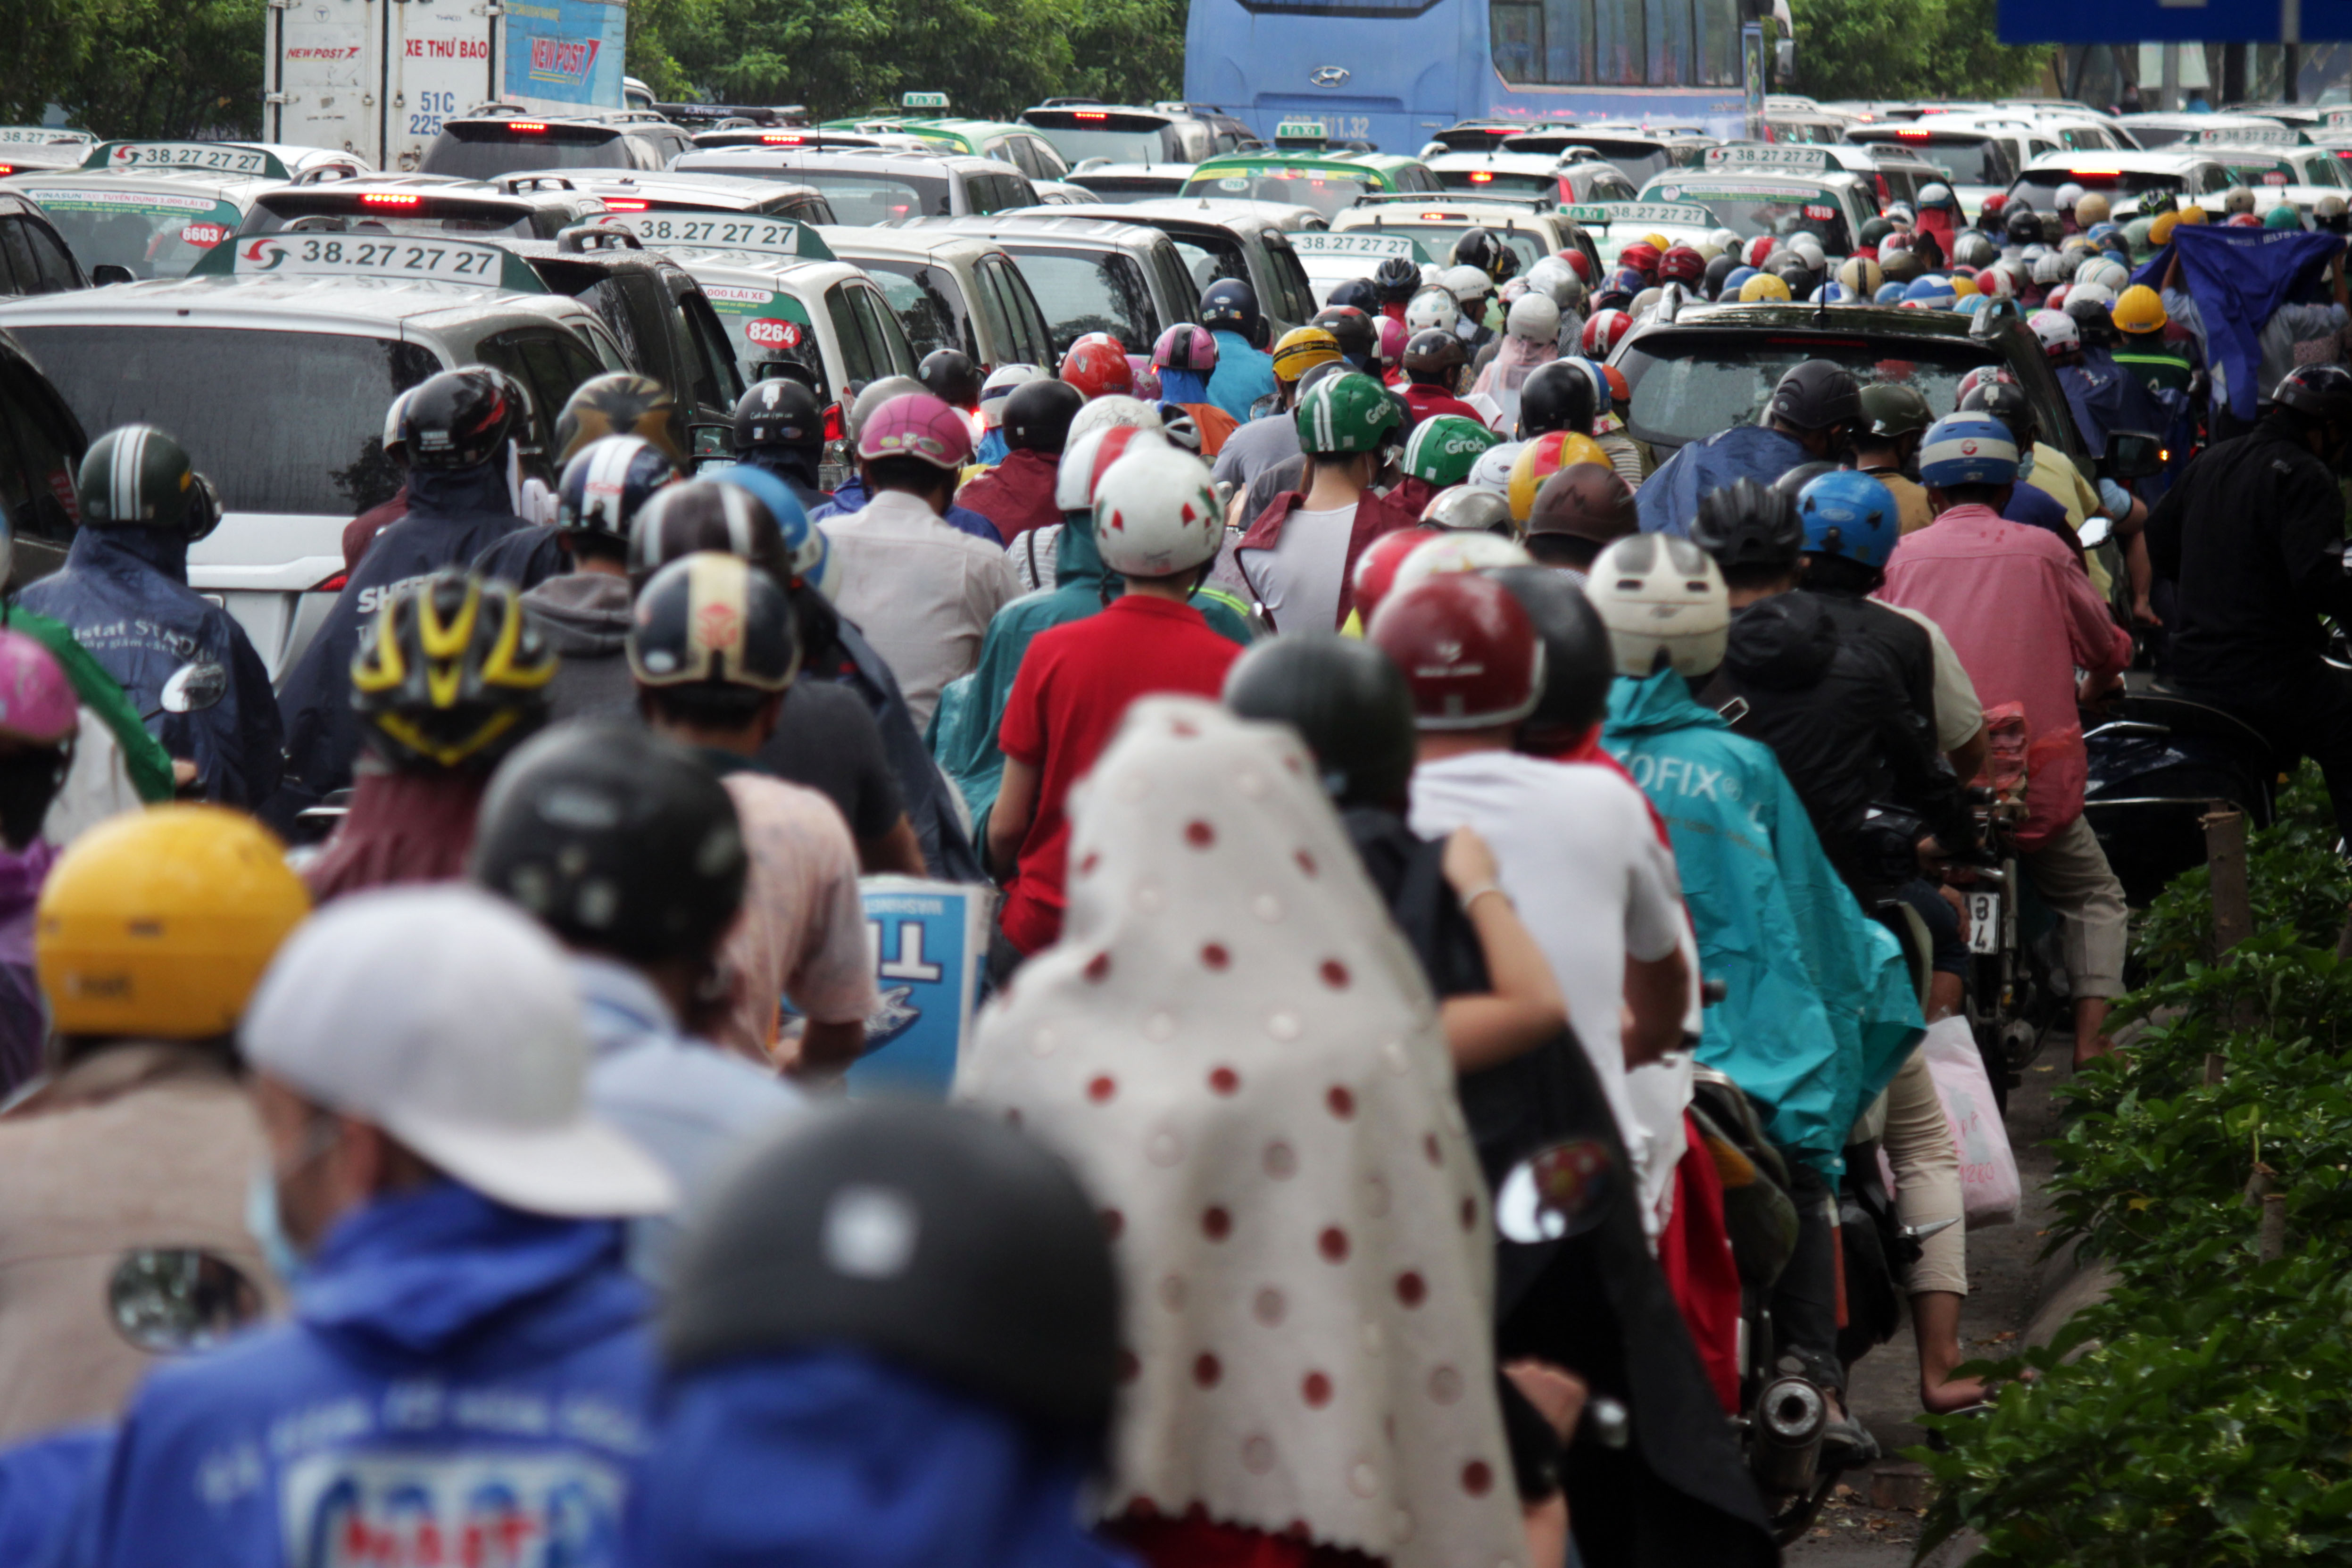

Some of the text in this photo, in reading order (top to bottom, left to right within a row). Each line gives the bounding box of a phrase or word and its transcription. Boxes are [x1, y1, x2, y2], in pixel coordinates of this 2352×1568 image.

[286, 48, 345, 59] NEW POST
[405, 36, 488, 58] XE THƯ BÁO
[530, 38, 586, 75] NEW POST
[421, 91, 455, 112] 51C
[409, 114, 442, 136] 225
[146, 149, 262, 170] 38.27 27 27
[1736, 149, 1824, 162] 38.27 27 27
[1611, 206, 1702, 221] 38.27 27 27
[182, 227, 218, 242] 6603
[640, 220, 794, 244] 38.27 27 27
[1303, 237, 1409, 253] 38.27 27 27
[301, 240, 494, 274] 38.27 27 27
[707, 288, 765, 300] 000 LÁI XE
[749, 322, 795, 344] 8264
[1365, 397, 1391, 424] Grab
[1445, 436, 1487, 454] Grab
[73, 619, 126, 641] istat
